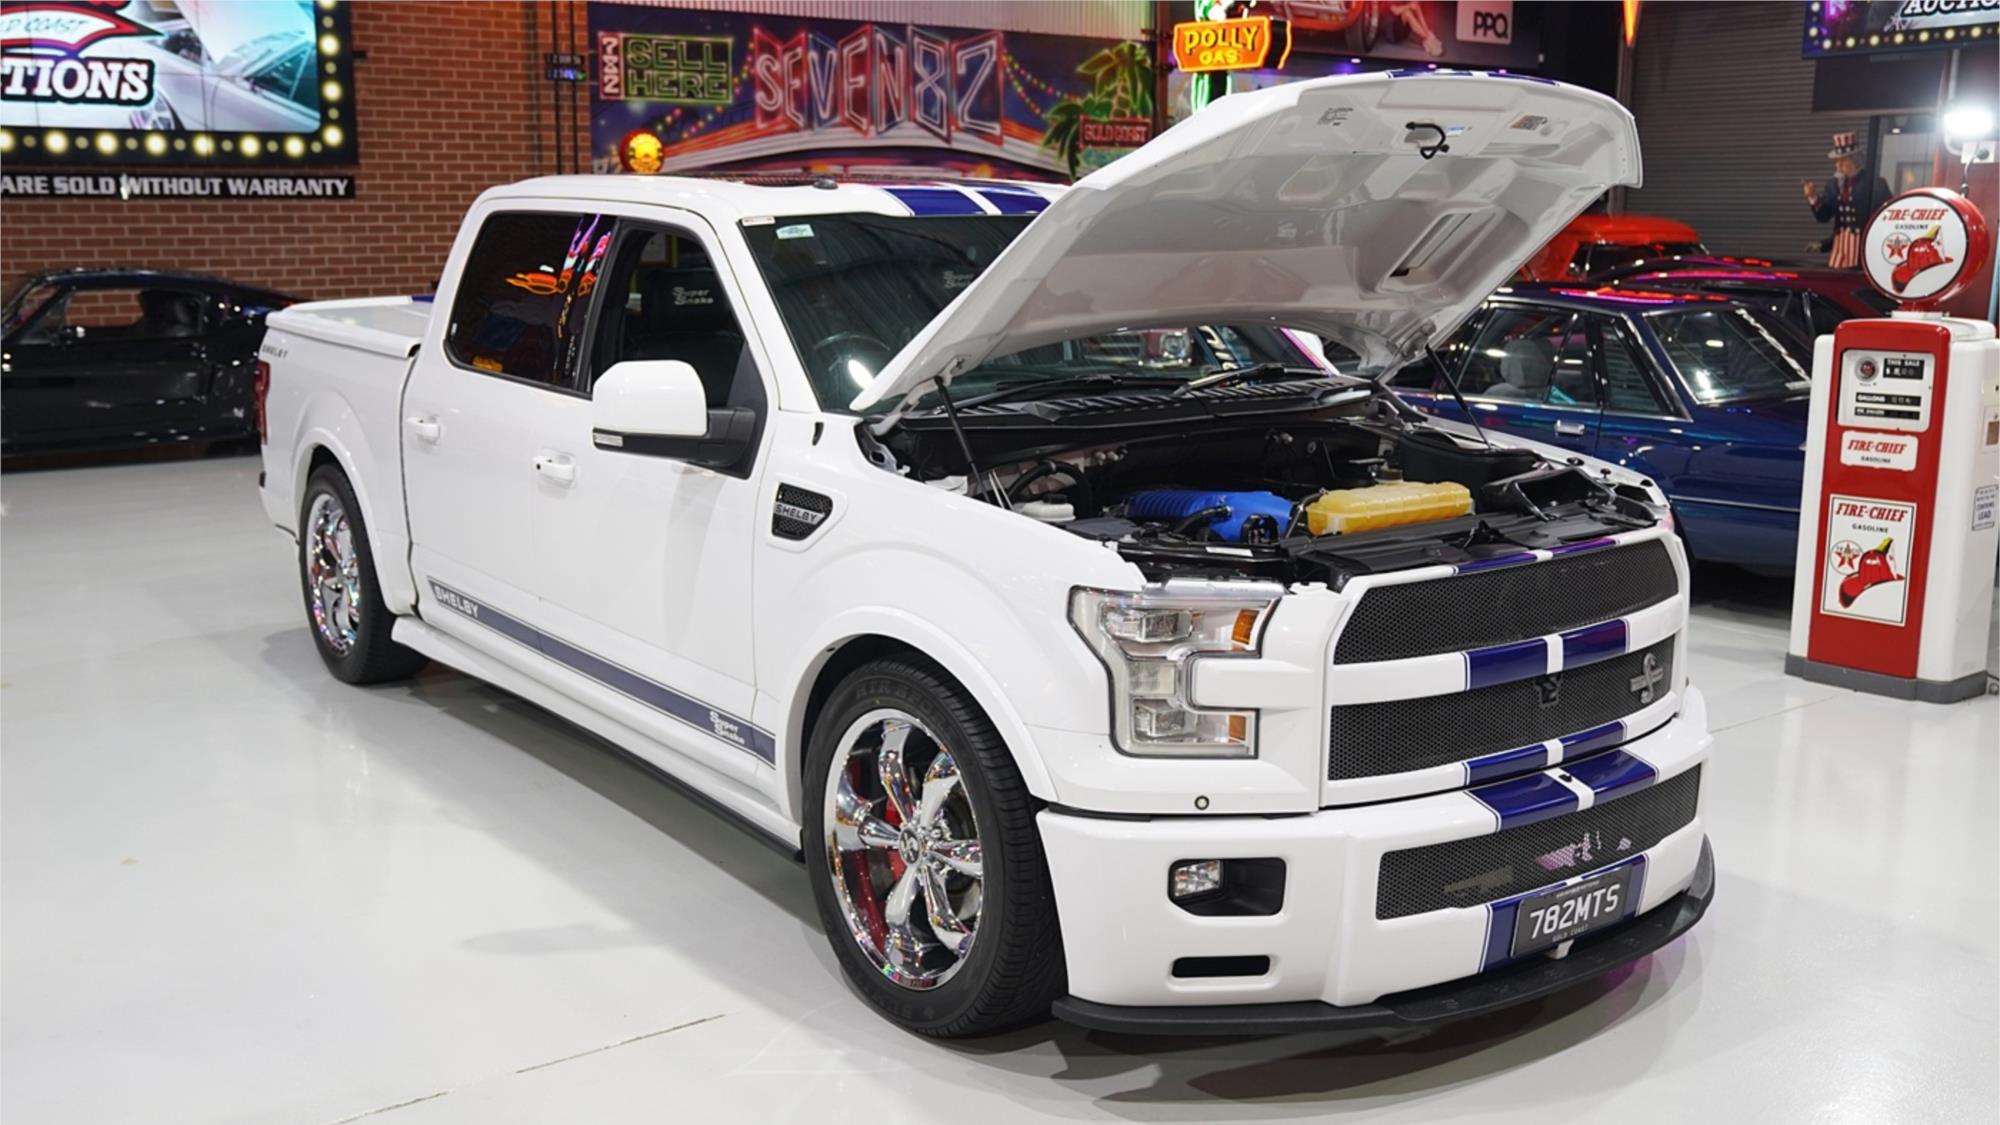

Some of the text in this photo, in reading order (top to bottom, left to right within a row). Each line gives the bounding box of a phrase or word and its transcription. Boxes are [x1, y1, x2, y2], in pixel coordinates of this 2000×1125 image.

[1473, 11, 1508, 39] PPQ
[1184, 25, 1258, 54] POLLY
[627, 39, 728, 71] SELL
[1199, 49, 1238, 64] GAS
[627, 69, 727, 99] HERE
[756, 32, 1001, 136] SEVEN82
[1115, 125, 1147, 142] COAST
[0, 176, 348, 196] ARE SOLD WITHOUT WARRANTY
[1848, 439, 1908, 455] FIRE-CHIEF
[776, 503, 817, 522] SHELBY
[1836, 502, 1908, 522] FIRE-CHIEF
[1852, 523, 1888, 533] GASOLINE
[434, 584, 478, 619] SHELBY
[709, 710, 738, 732] Super
[714, 722, 745, 745] Snake
[1530, 883, 1621, 939] 782MTS
